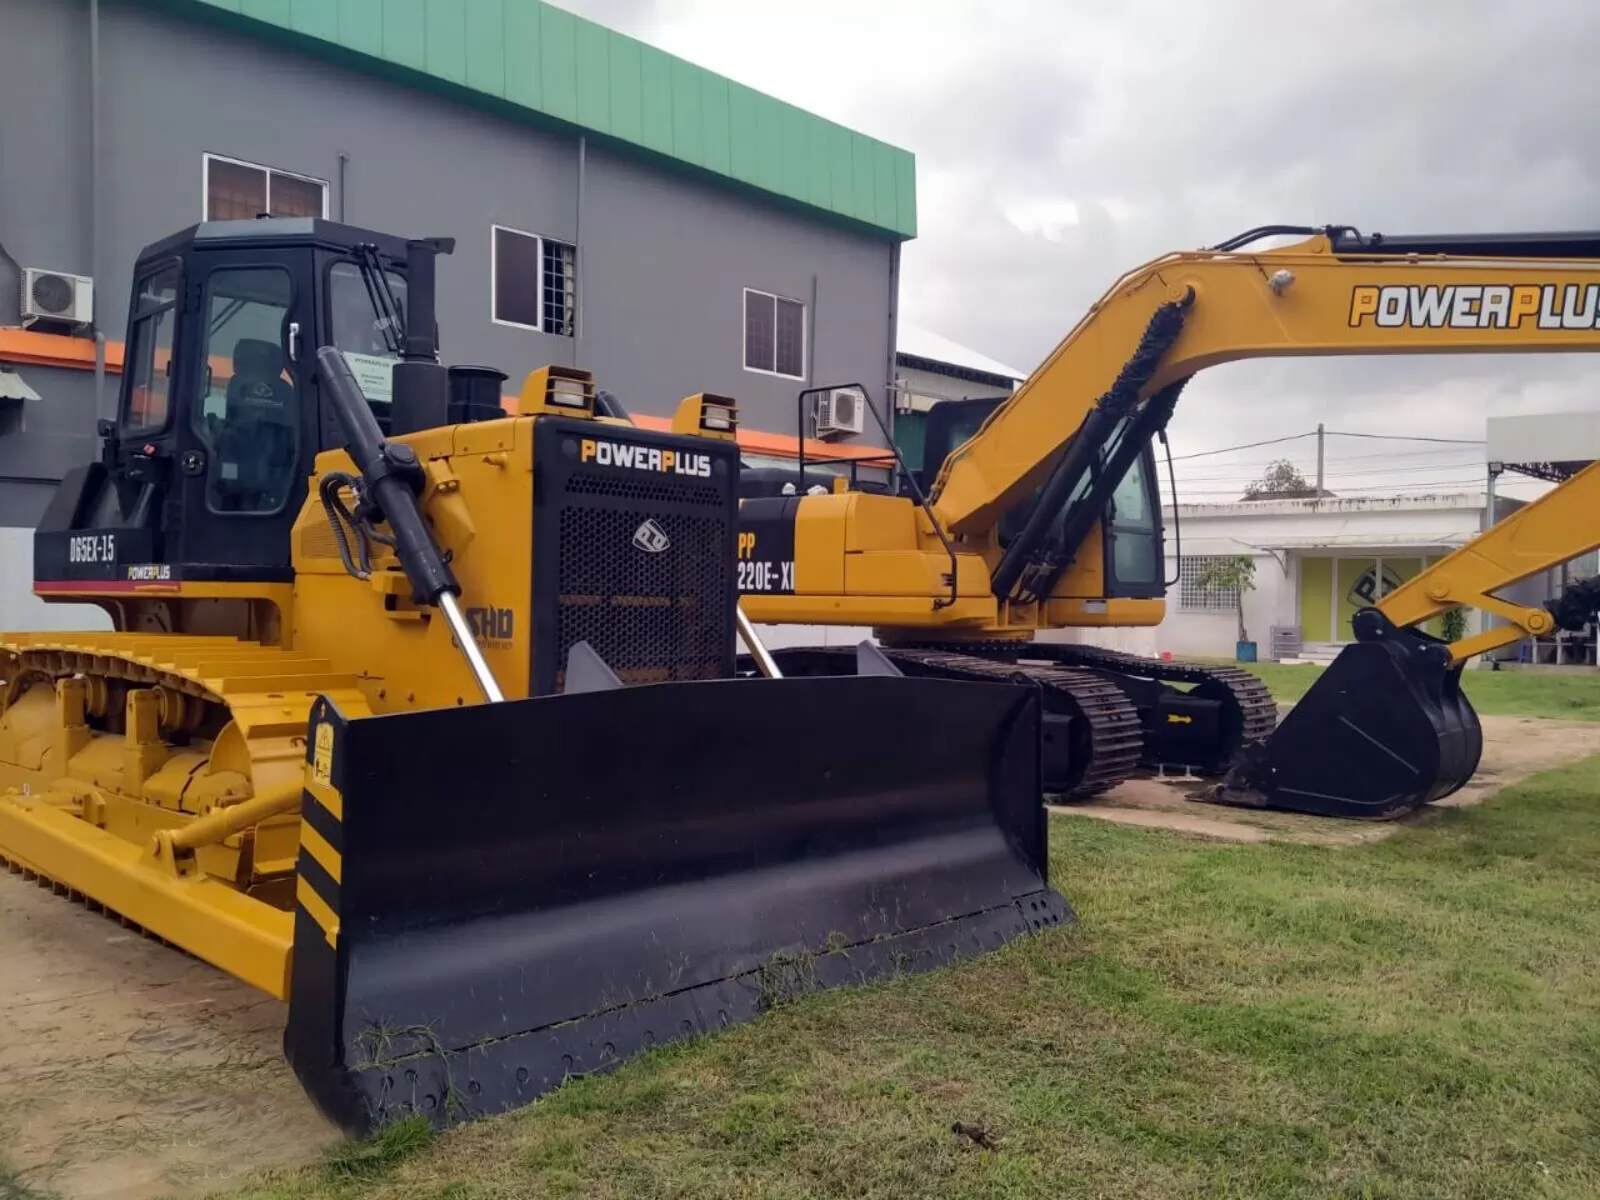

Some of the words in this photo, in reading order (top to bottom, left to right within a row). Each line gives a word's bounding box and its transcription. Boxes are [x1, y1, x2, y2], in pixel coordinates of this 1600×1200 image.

[1349, 284, 1600, 329] POWERPLU
[581, 438, 711, 477] POWERPLUS
[738, 532, 756, 559] PP
[127, 564, 171, 580] POWERPLUS
